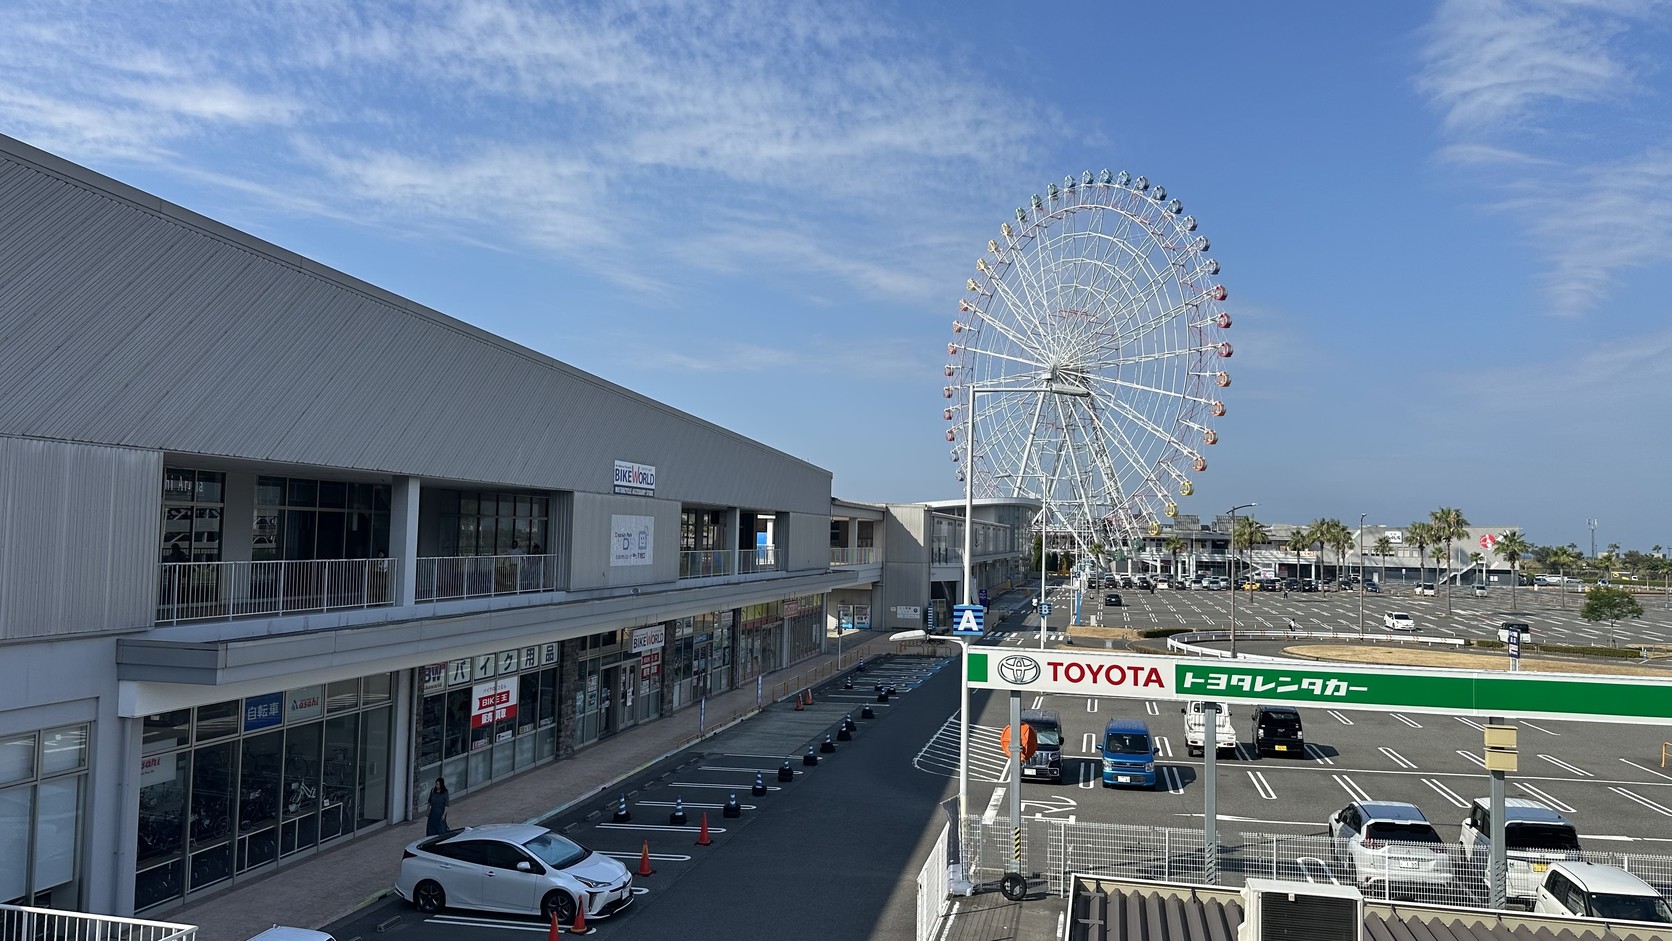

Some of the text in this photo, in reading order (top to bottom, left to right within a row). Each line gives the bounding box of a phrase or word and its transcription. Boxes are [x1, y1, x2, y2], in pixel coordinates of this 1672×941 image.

[615, 465, 655, 486] BIKEWORLD
[1042, 604, 1049, 614] B
[957, 609, 979, 631] A
[453, 644, 555, 682] バイク用品
[1047, 661, 1165, 688] TOYOTA
[1183, 672, 1368, 697] トヨタレンタカー
[247, 702, 280, 721] 自転車
[141, 757, 161, 770] sahi
